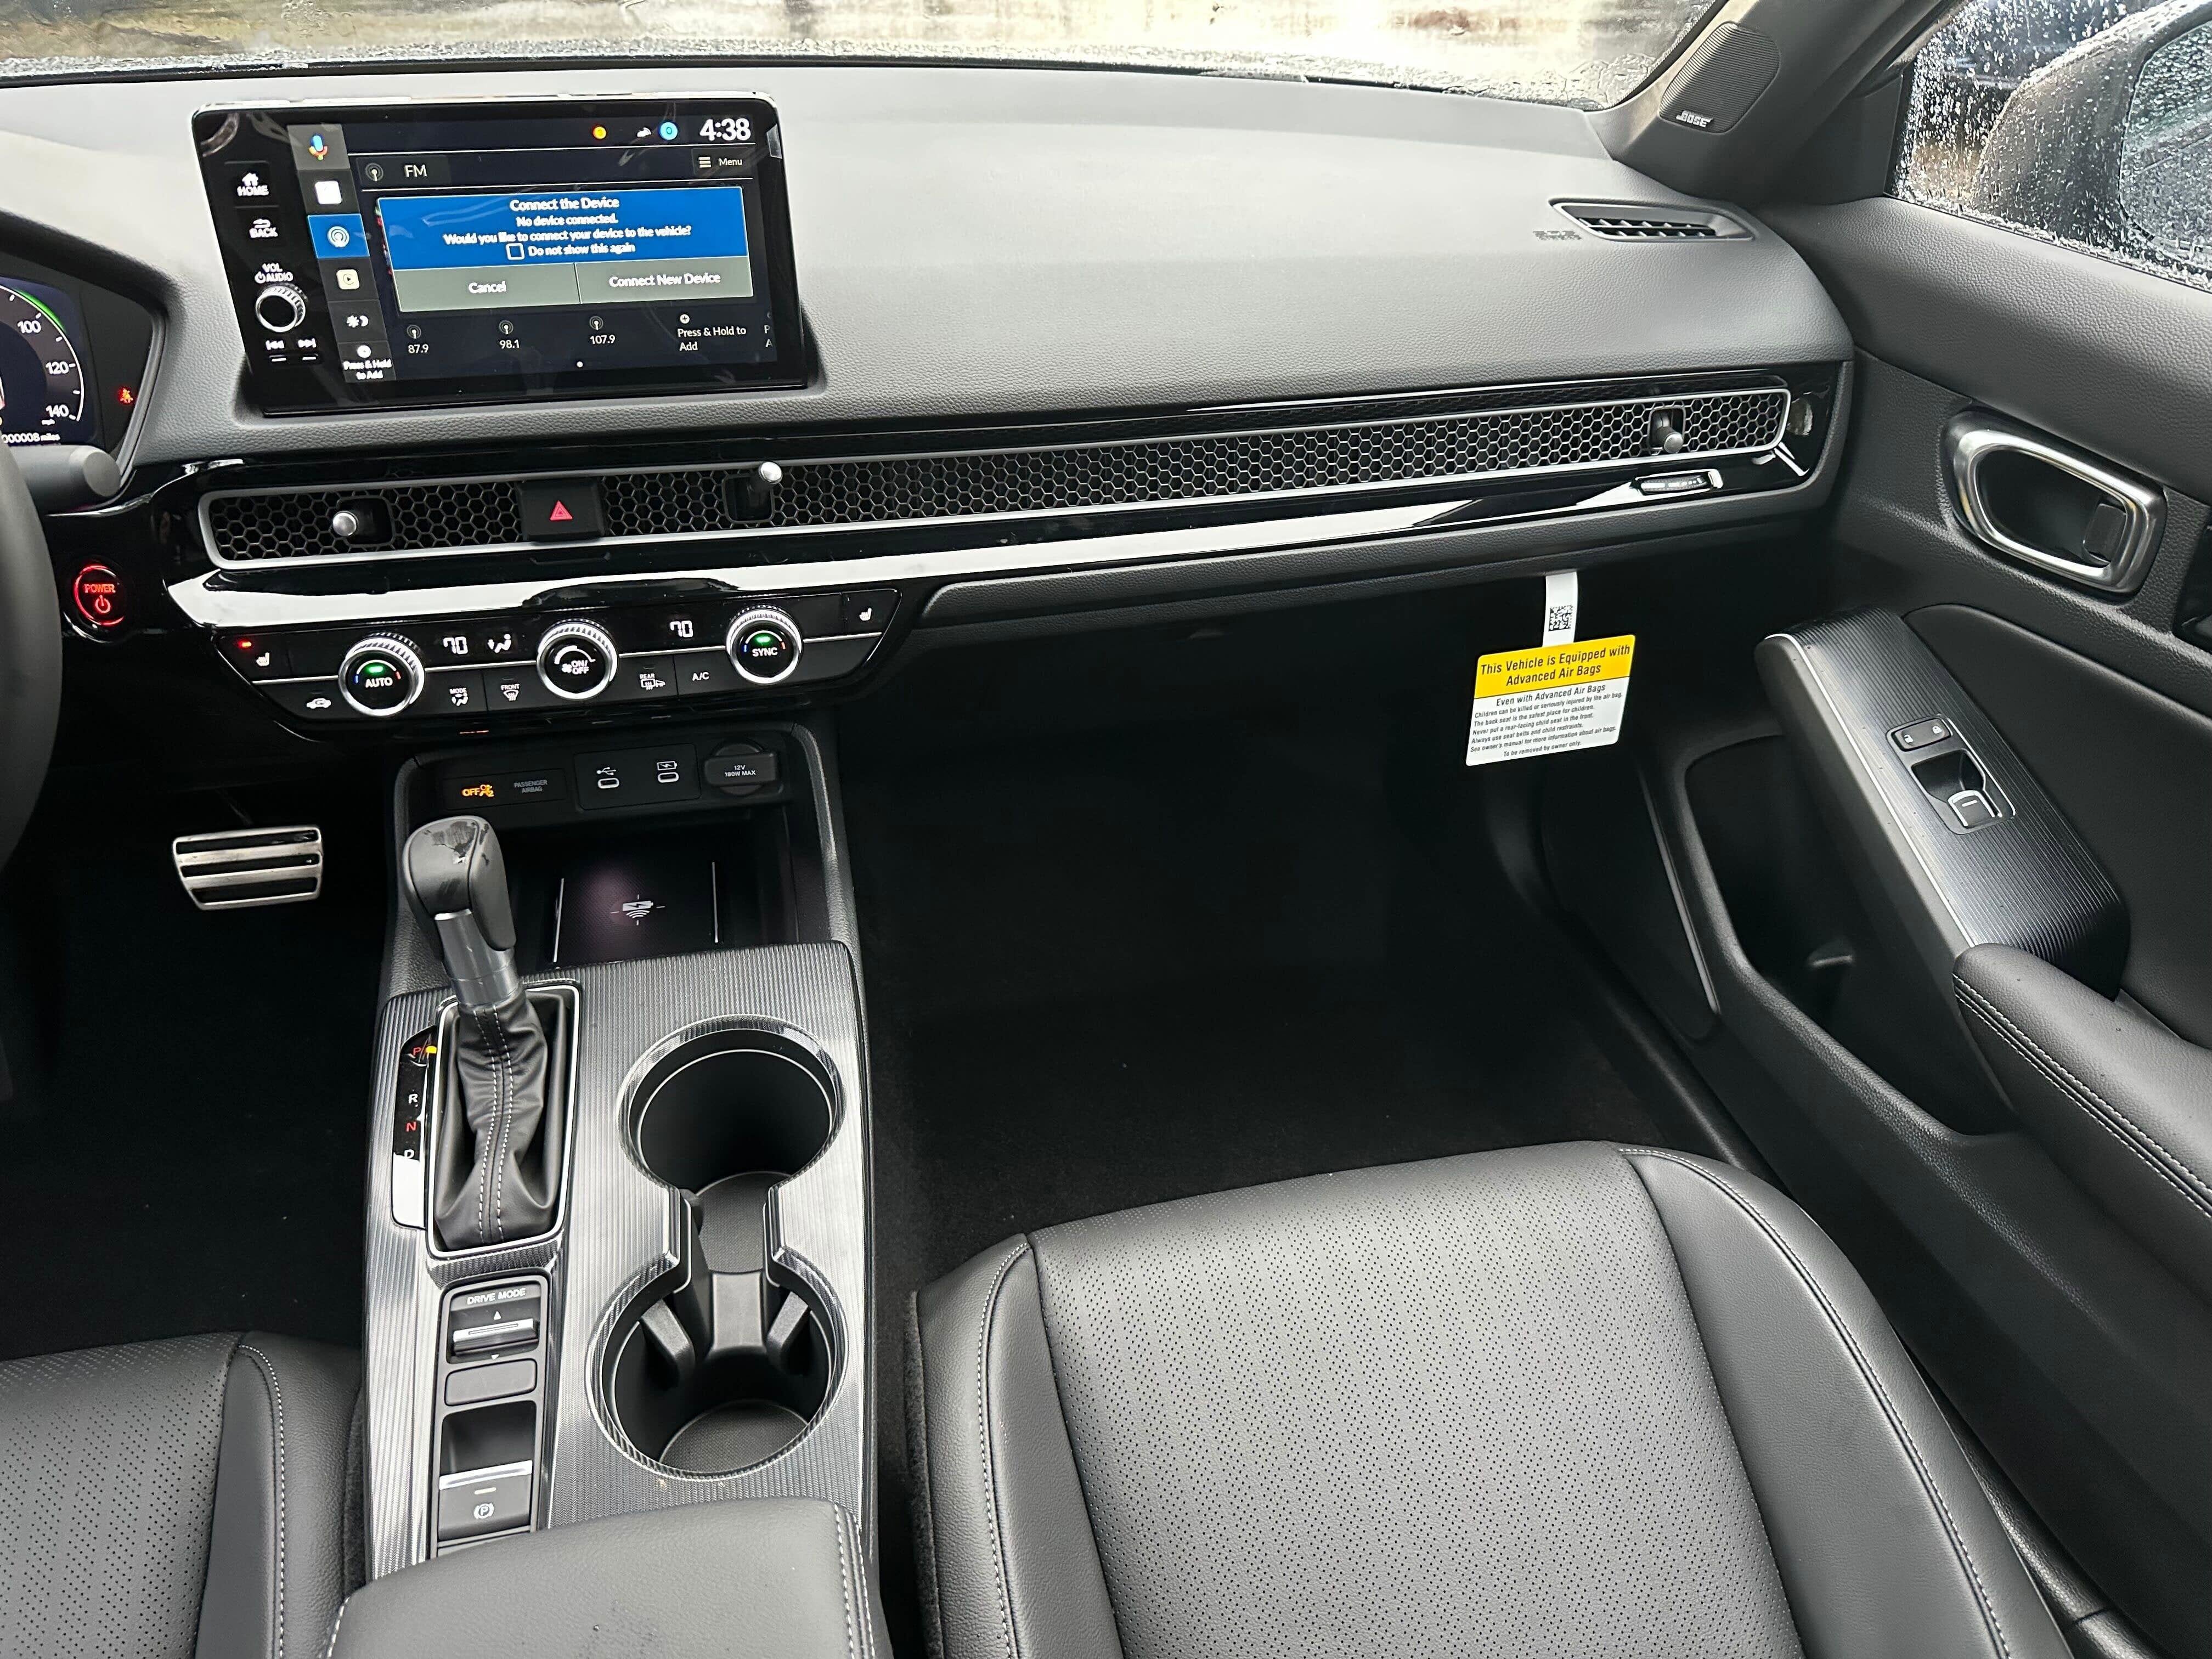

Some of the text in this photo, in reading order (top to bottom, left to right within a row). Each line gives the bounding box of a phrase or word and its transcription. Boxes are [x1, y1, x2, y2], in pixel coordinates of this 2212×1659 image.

[1676, 110, 1714, 128] BOSE
[699, 118, 751, 141] 4:38
[404, 165, 427, 177] FM
[237, 185, 269, 196] HOME
[510, 196, 619, 211] Connect the Device
[516, 213, 619, 227] No device connected.
[249, 227, 278, 238] BACK
[443, 225, 692, 245] Would you like to connect your device to the vehicle?
[528, 242, 636, 256] Do not show this again
[262, 263, 283, 273] VOL
[266, 272, 293, 282] AUDIO
[609, 272, 721, 287] Connect New Device
[468, 280, 507, 294] Cancel
[17, 320, 42, 334] 100
[677, 326, 747, 337] Press & Hold to
[499, 338, 520, 349] 98.1
[589, 334, 616, 345] 107.9
[408, 343, 429, 354] 87.9
[679, 341, 698, 351] Add
[45, 361, 70, 374] 120
[46, 404, 69, 417] 140
[40, 433, 60, 441] miles
[84, 583, 116, 593] POWER
[670, 620, 694, 638] 70
[443, 636, 467, 655] 70
[752, 646, 778, 658] SYNC
[571, 659, 588, 668] ON/
[1481, 645, 1630, 675] This Vehicle is Equipped with
[572, 667, 589, 675] OFF
[692, 671, 710, 681] A/C
[1506, 665, 1601, 686] Advanced Air Bags
[365, 677, 393, 689] AUTO
[501, 682, 520, 691] FRONT
[449, 687, 467, 696] MODE
[1497, 698, 1514, 706] Even
[1517, 694, 1532, 703] with
[1535, 688, 1572, 701] Advanced
[1588, 685, 1606, 693] Bags
[1541, 701, 1565, 709] seriously
[1505, 722, 1534, 730] rear-facing
[1548, 732, 1577, 740] information
[1519, 746, 1542, 754] removed
[514, 780, 548, 788] PASSENGER
[462, 788, 480, 797] OFF
[413, 1047, 422, 1056] P
[408, 1093, 419, 1104] R
[405, 1121, 417, 1132] N
[404, 1149, 415, 1159] D
[467, 1287, 526, 1305] DRIVE MODE
